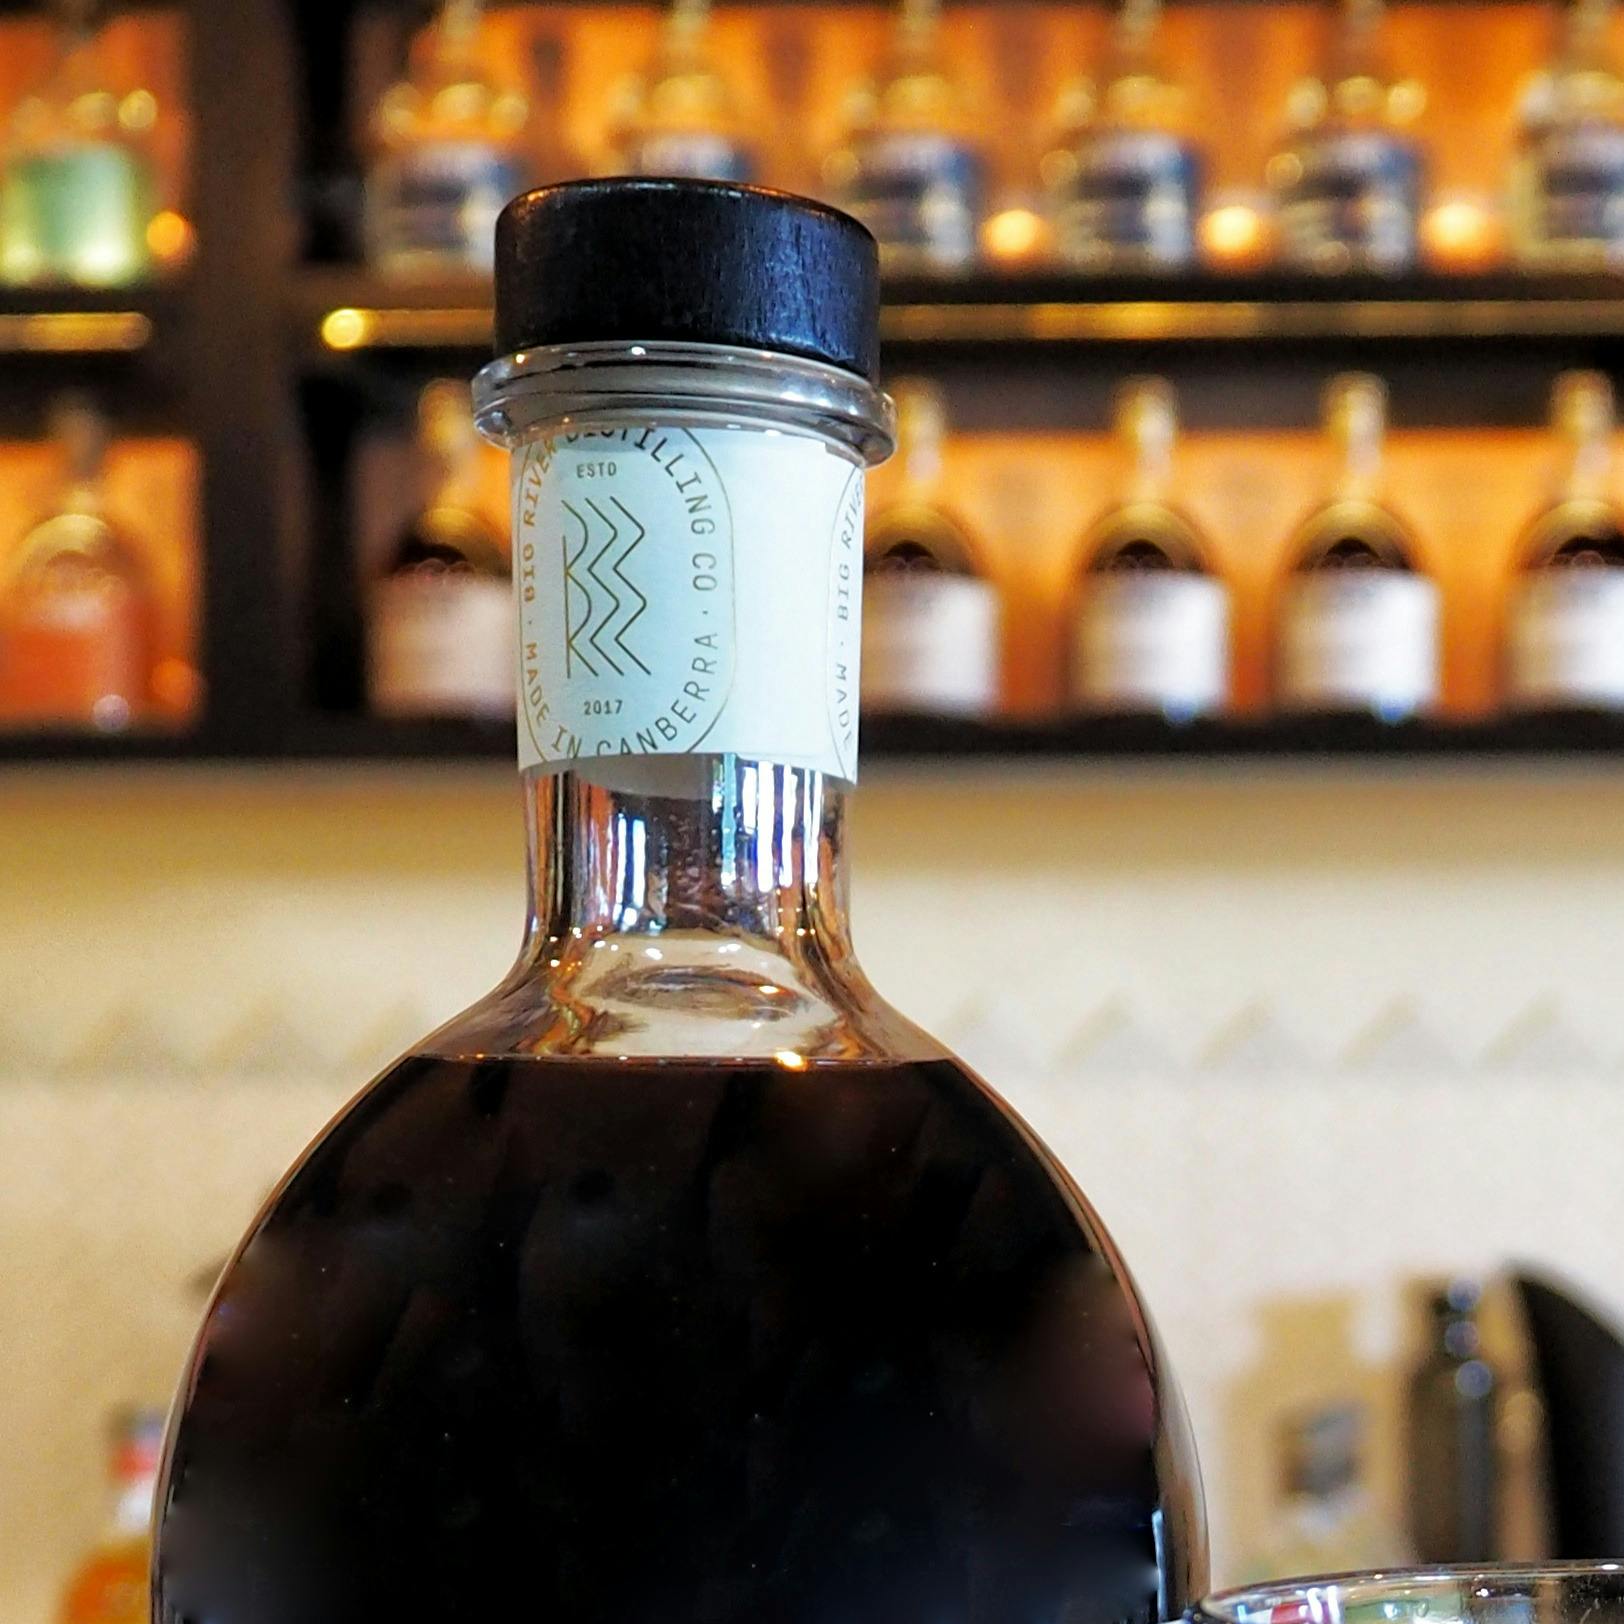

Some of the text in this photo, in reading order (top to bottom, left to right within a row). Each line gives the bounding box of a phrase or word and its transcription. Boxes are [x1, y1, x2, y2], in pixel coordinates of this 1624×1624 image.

[576, 461, 617, 479] ESTD
[525, 632, 719, 760] MADE IN CANBERRA
[584, 700, 623, 716] 2017
